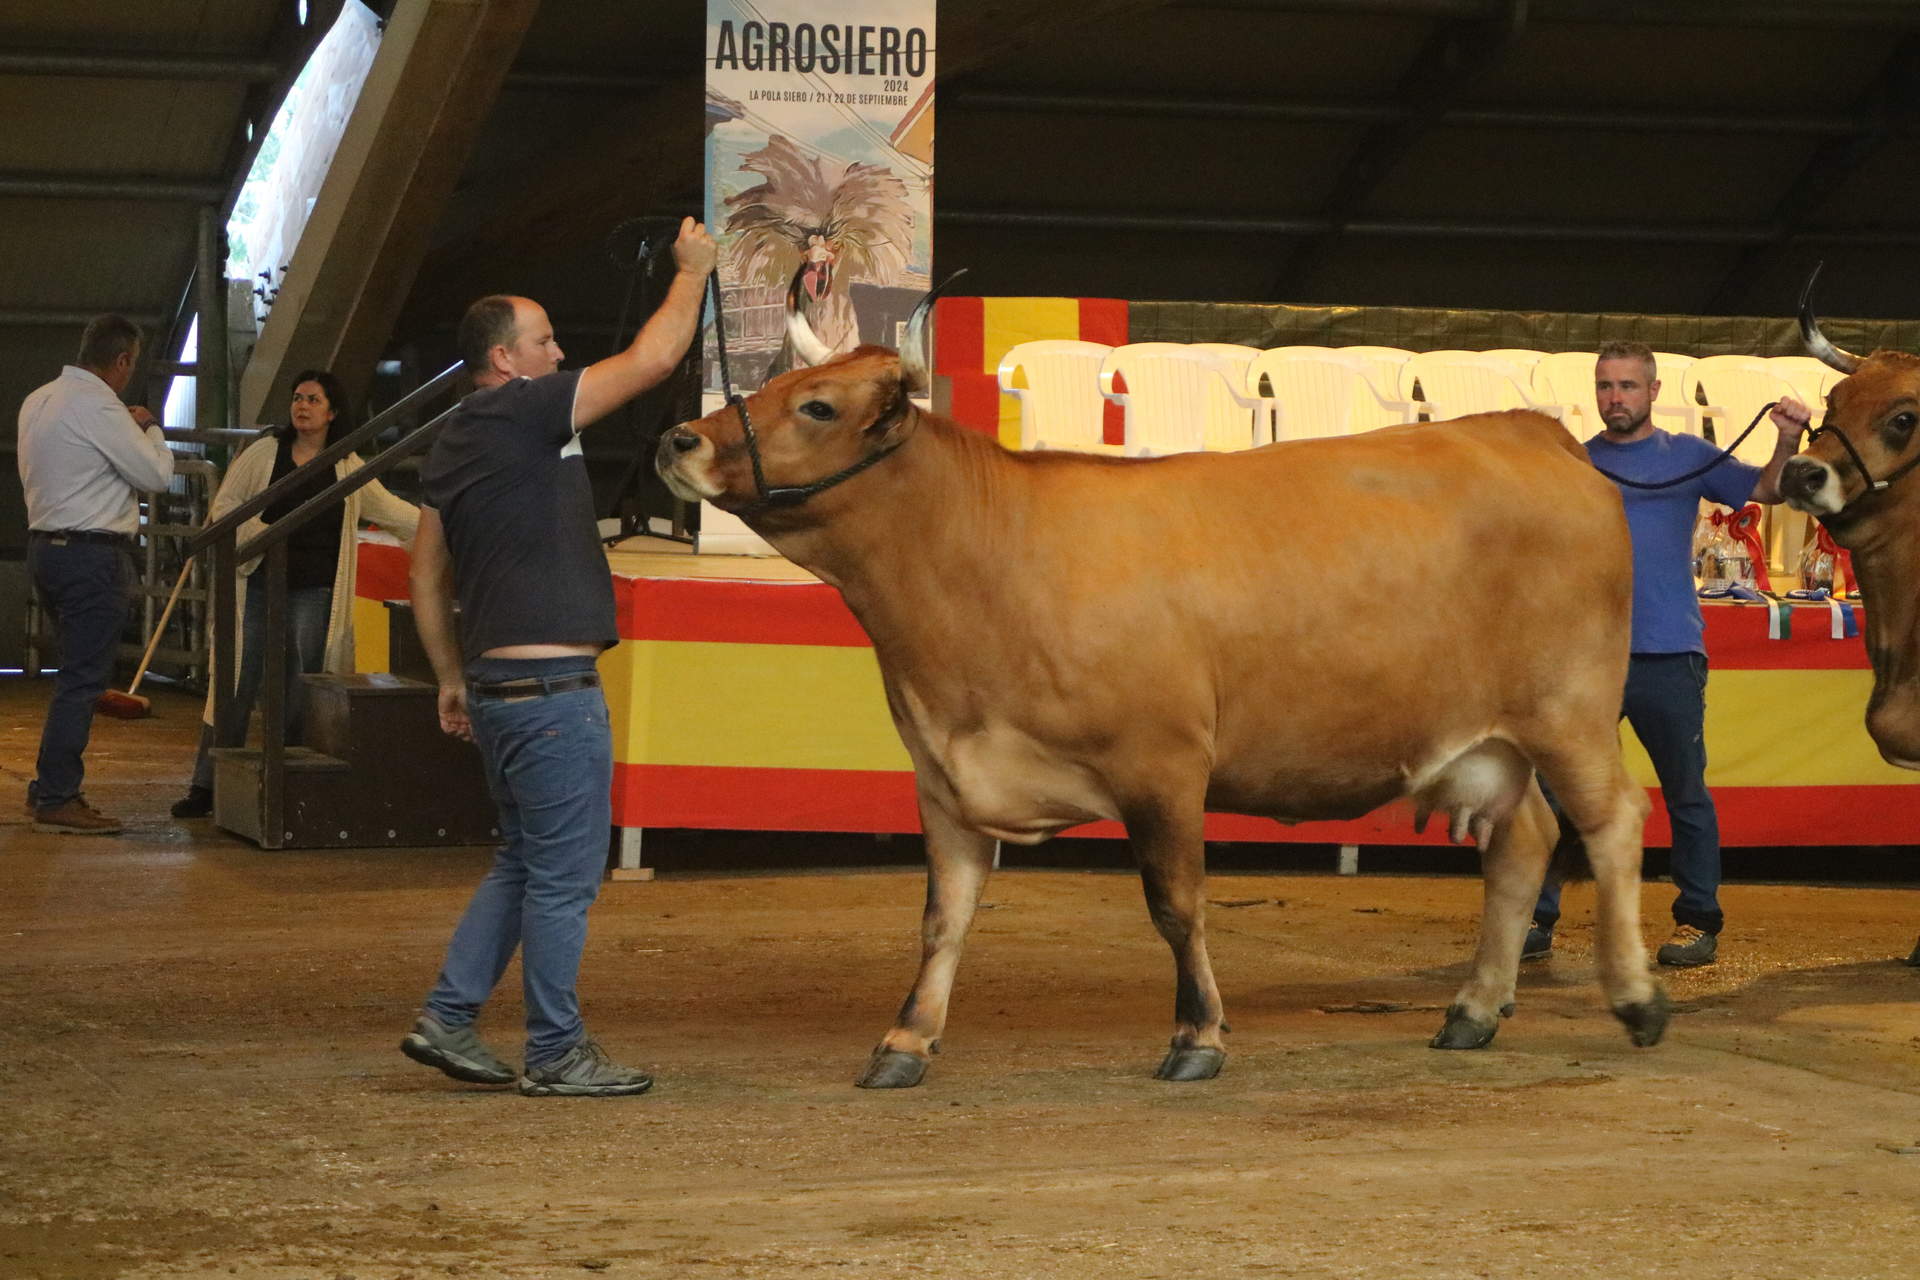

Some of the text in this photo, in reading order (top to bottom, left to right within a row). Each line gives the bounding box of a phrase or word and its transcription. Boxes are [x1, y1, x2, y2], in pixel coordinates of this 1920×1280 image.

[714, 20, 927, 78] AGROSIERO
[884, 80, 909, 92] 2024
[749, 90, 759, 101] LA
[761, 90, 781, 102] POLA
[783, 91, 807, 103] SIERO
[816, 92, 826, 103] 21
[826, 93, 832, 103] Y
[834, 93, 845, 104] 22
[846, 93, 856, 104] DE
[858, 94, 908, 106] SEPTIEMBRE
